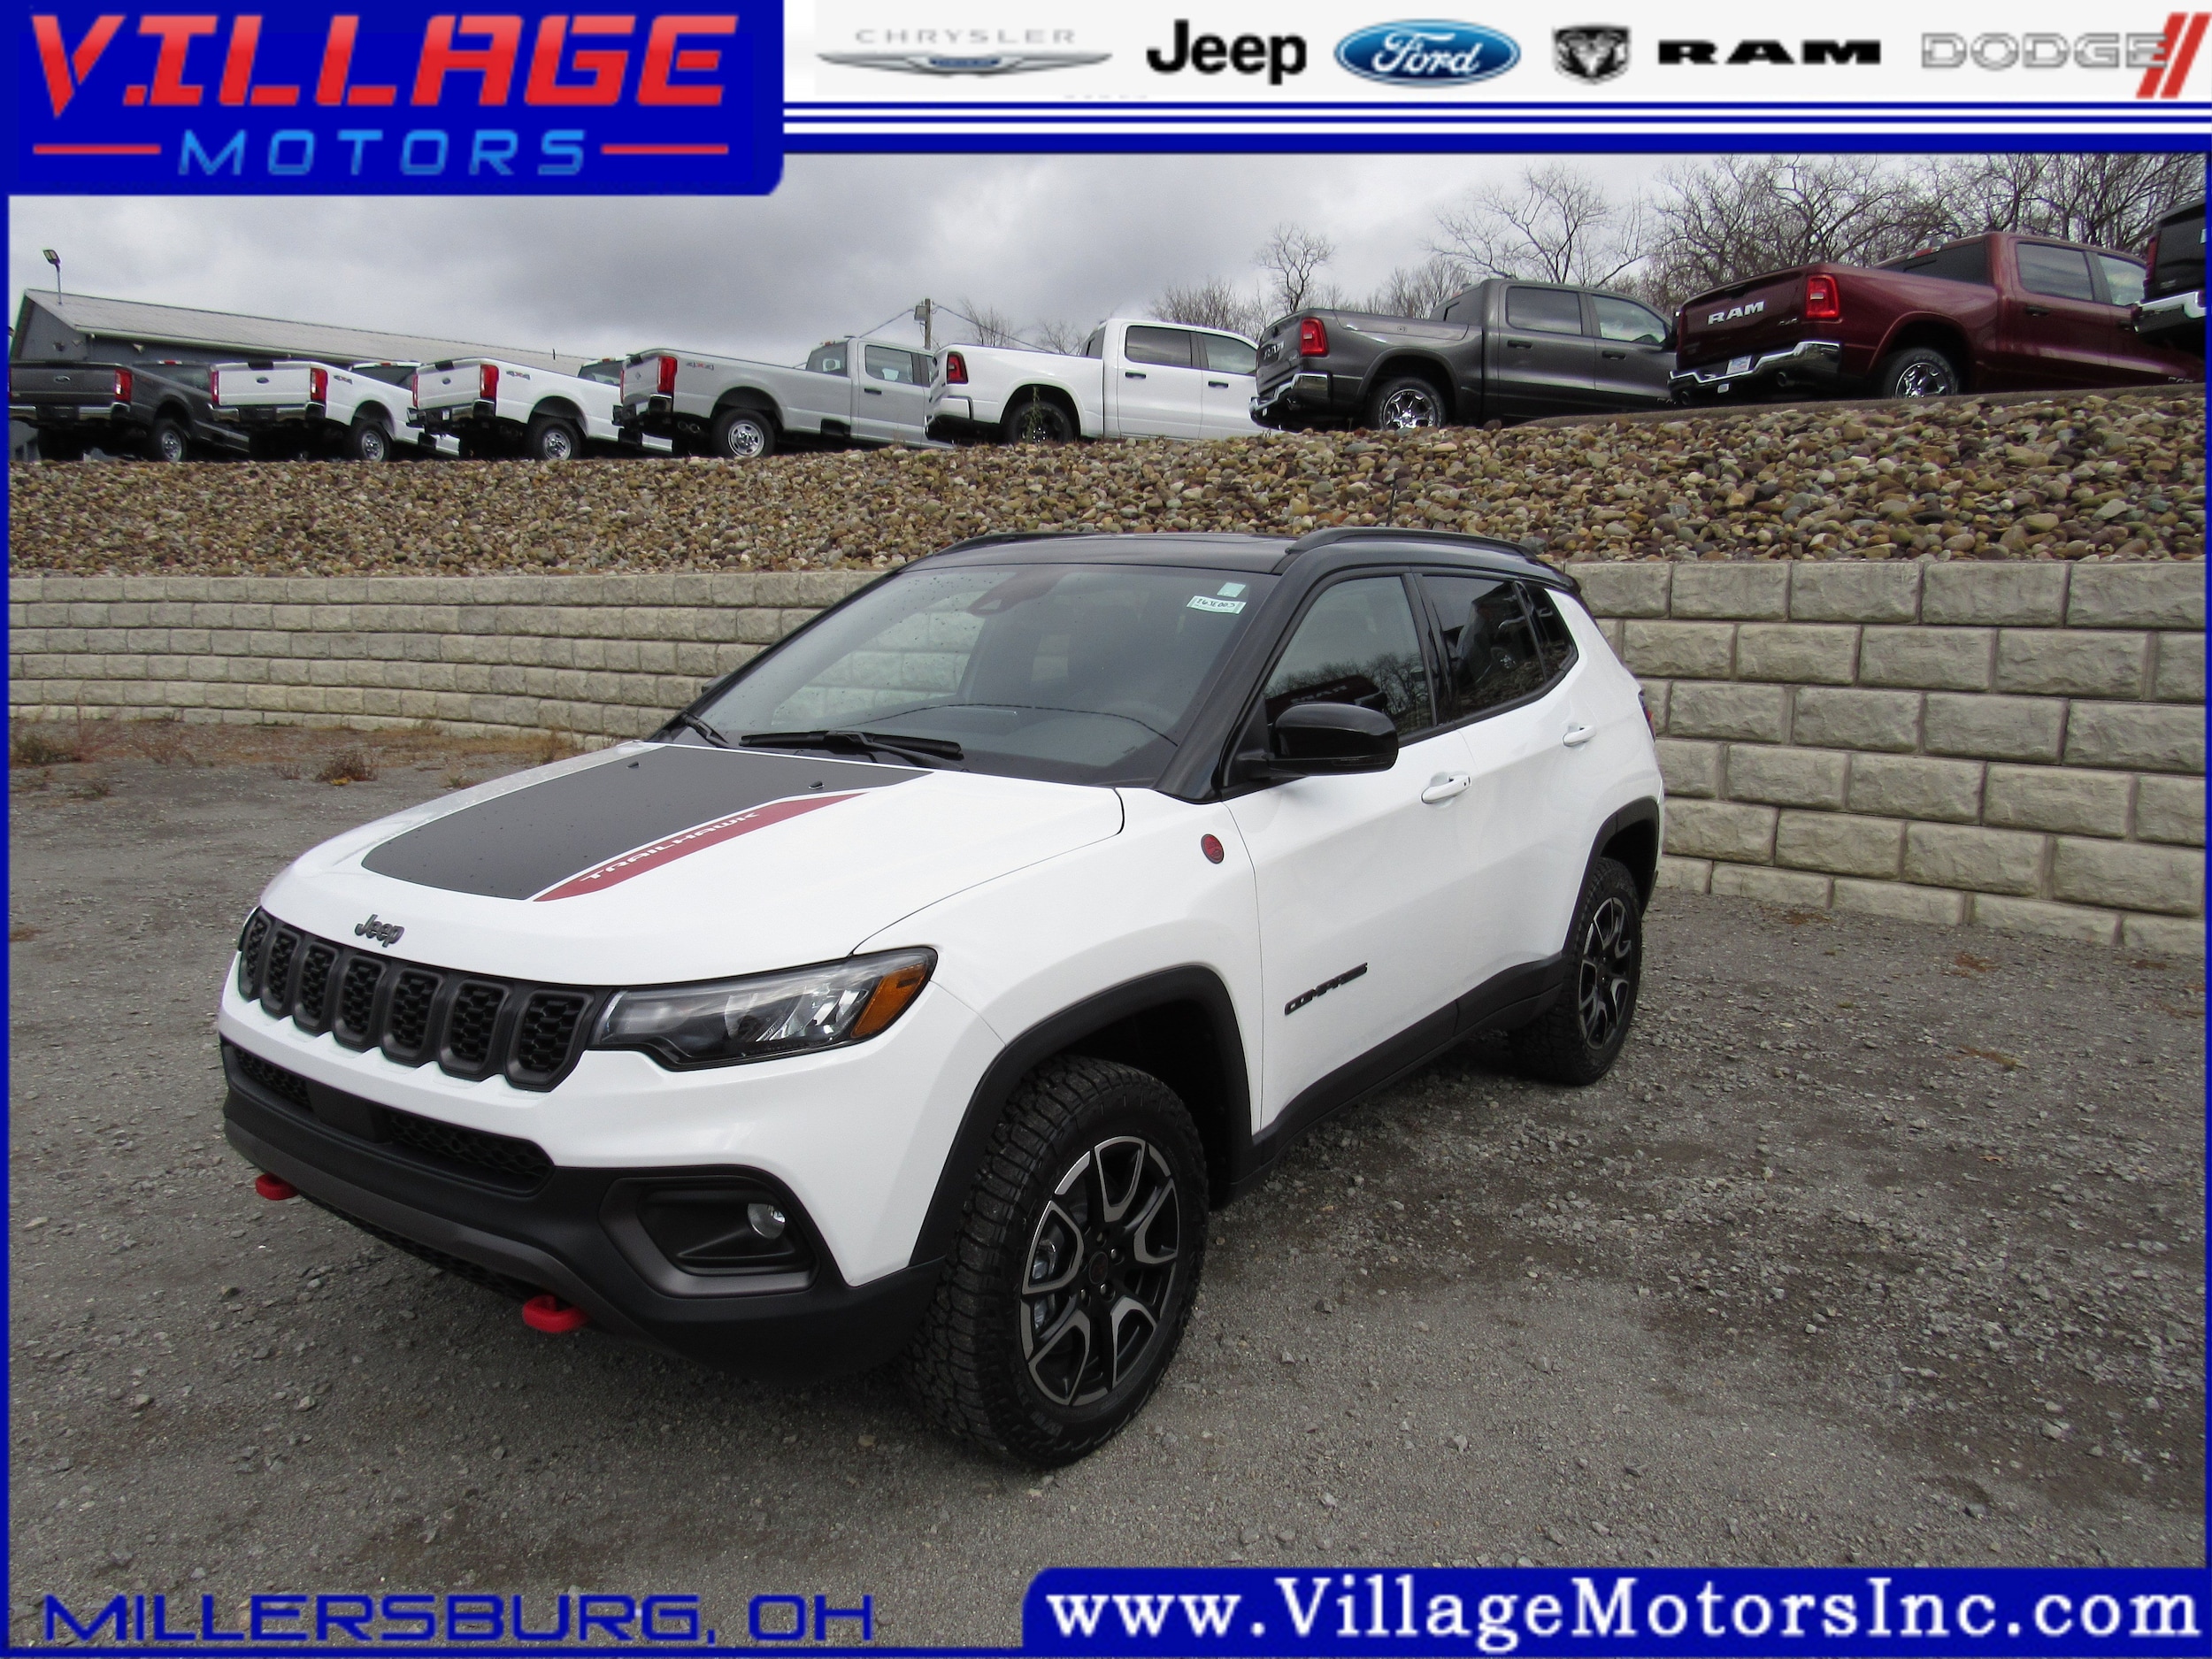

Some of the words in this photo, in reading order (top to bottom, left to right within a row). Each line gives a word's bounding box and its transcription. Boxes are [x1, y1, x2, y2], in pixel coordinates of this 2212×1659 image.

[1708, 301, 1764, 325] RAM
[580, 811, 760, 882] TRAILHAWK
[355, 914, 405, 948] Jeep
